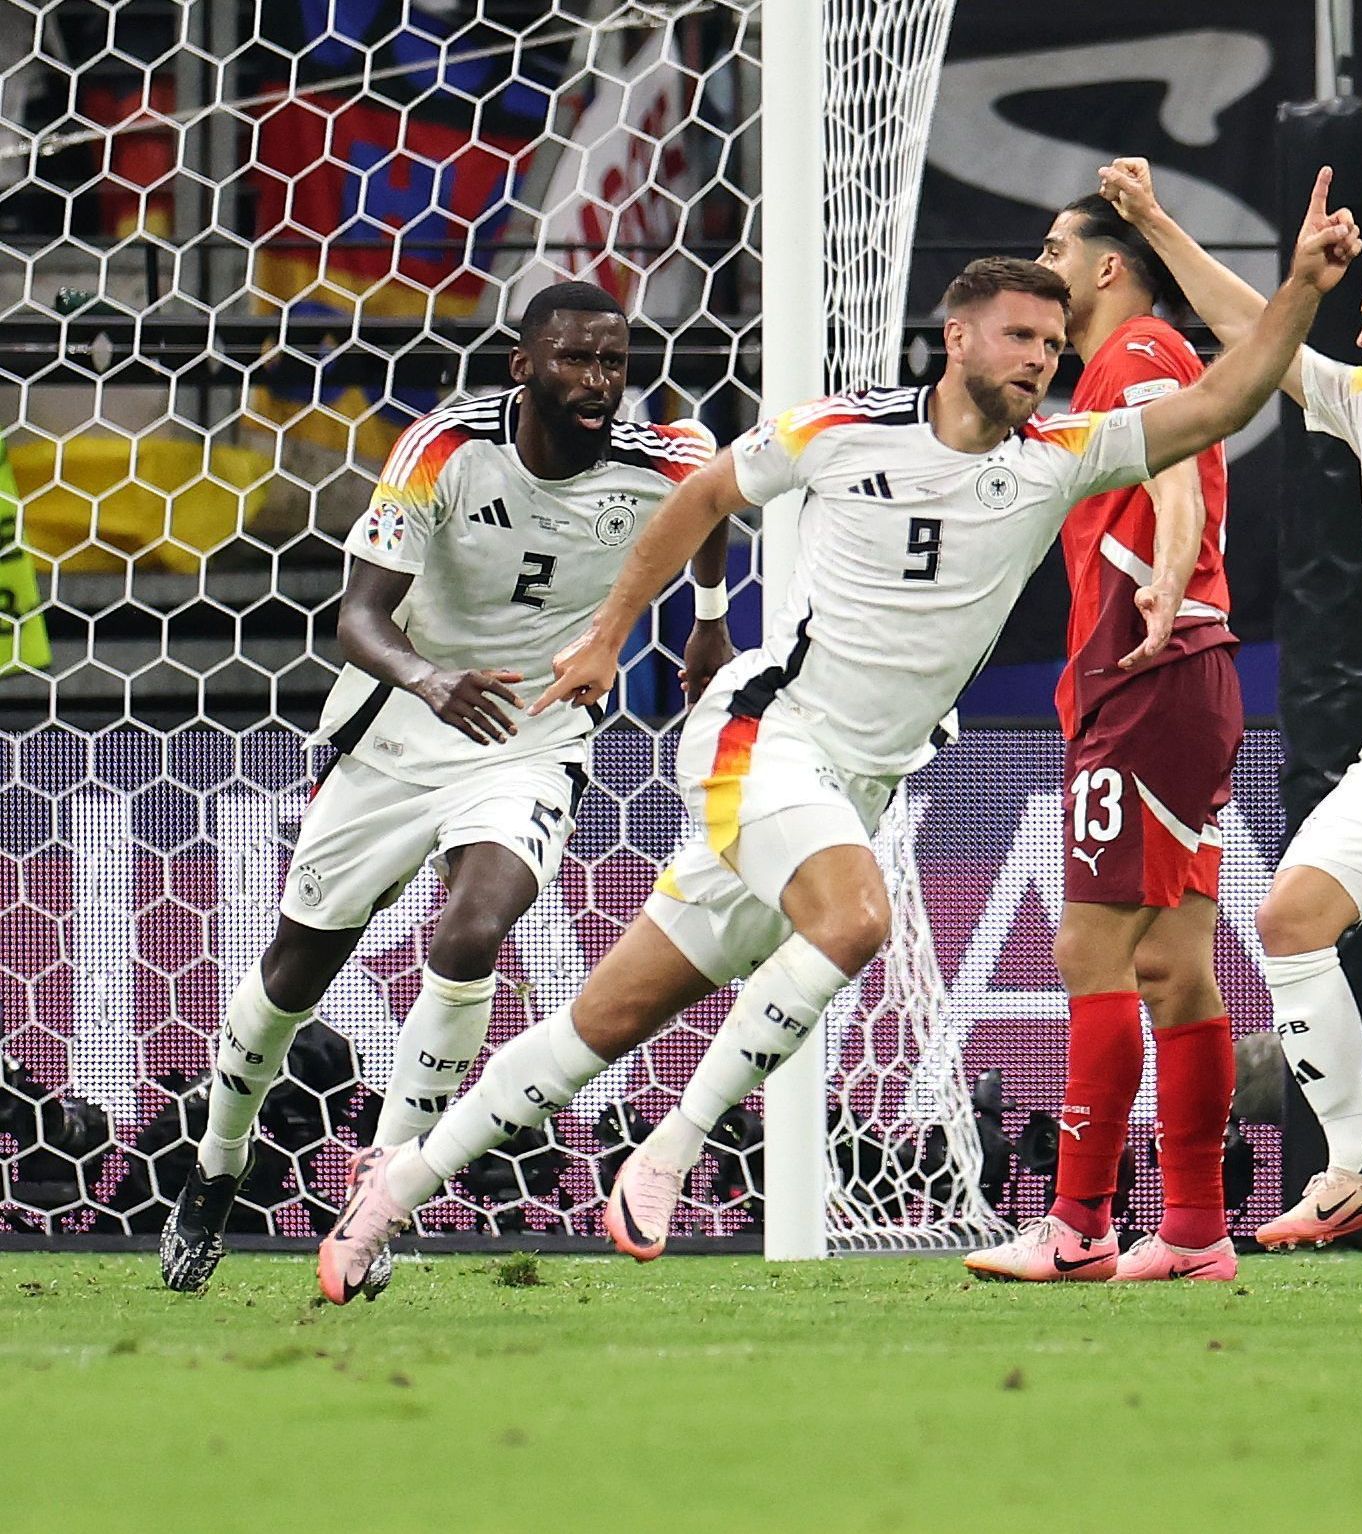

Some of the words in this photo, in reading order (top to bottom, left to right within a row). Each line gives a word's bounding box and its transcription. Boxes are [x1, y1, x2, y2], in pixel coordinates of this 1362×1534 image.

[511, 550, 557, 611] 2
[903, 516, 943, 584] 9
[1070, 767, 1124, 843] 13
[225, 1018, 264, 1065] DFB
[418, 1050, 470, 1074] DFB
